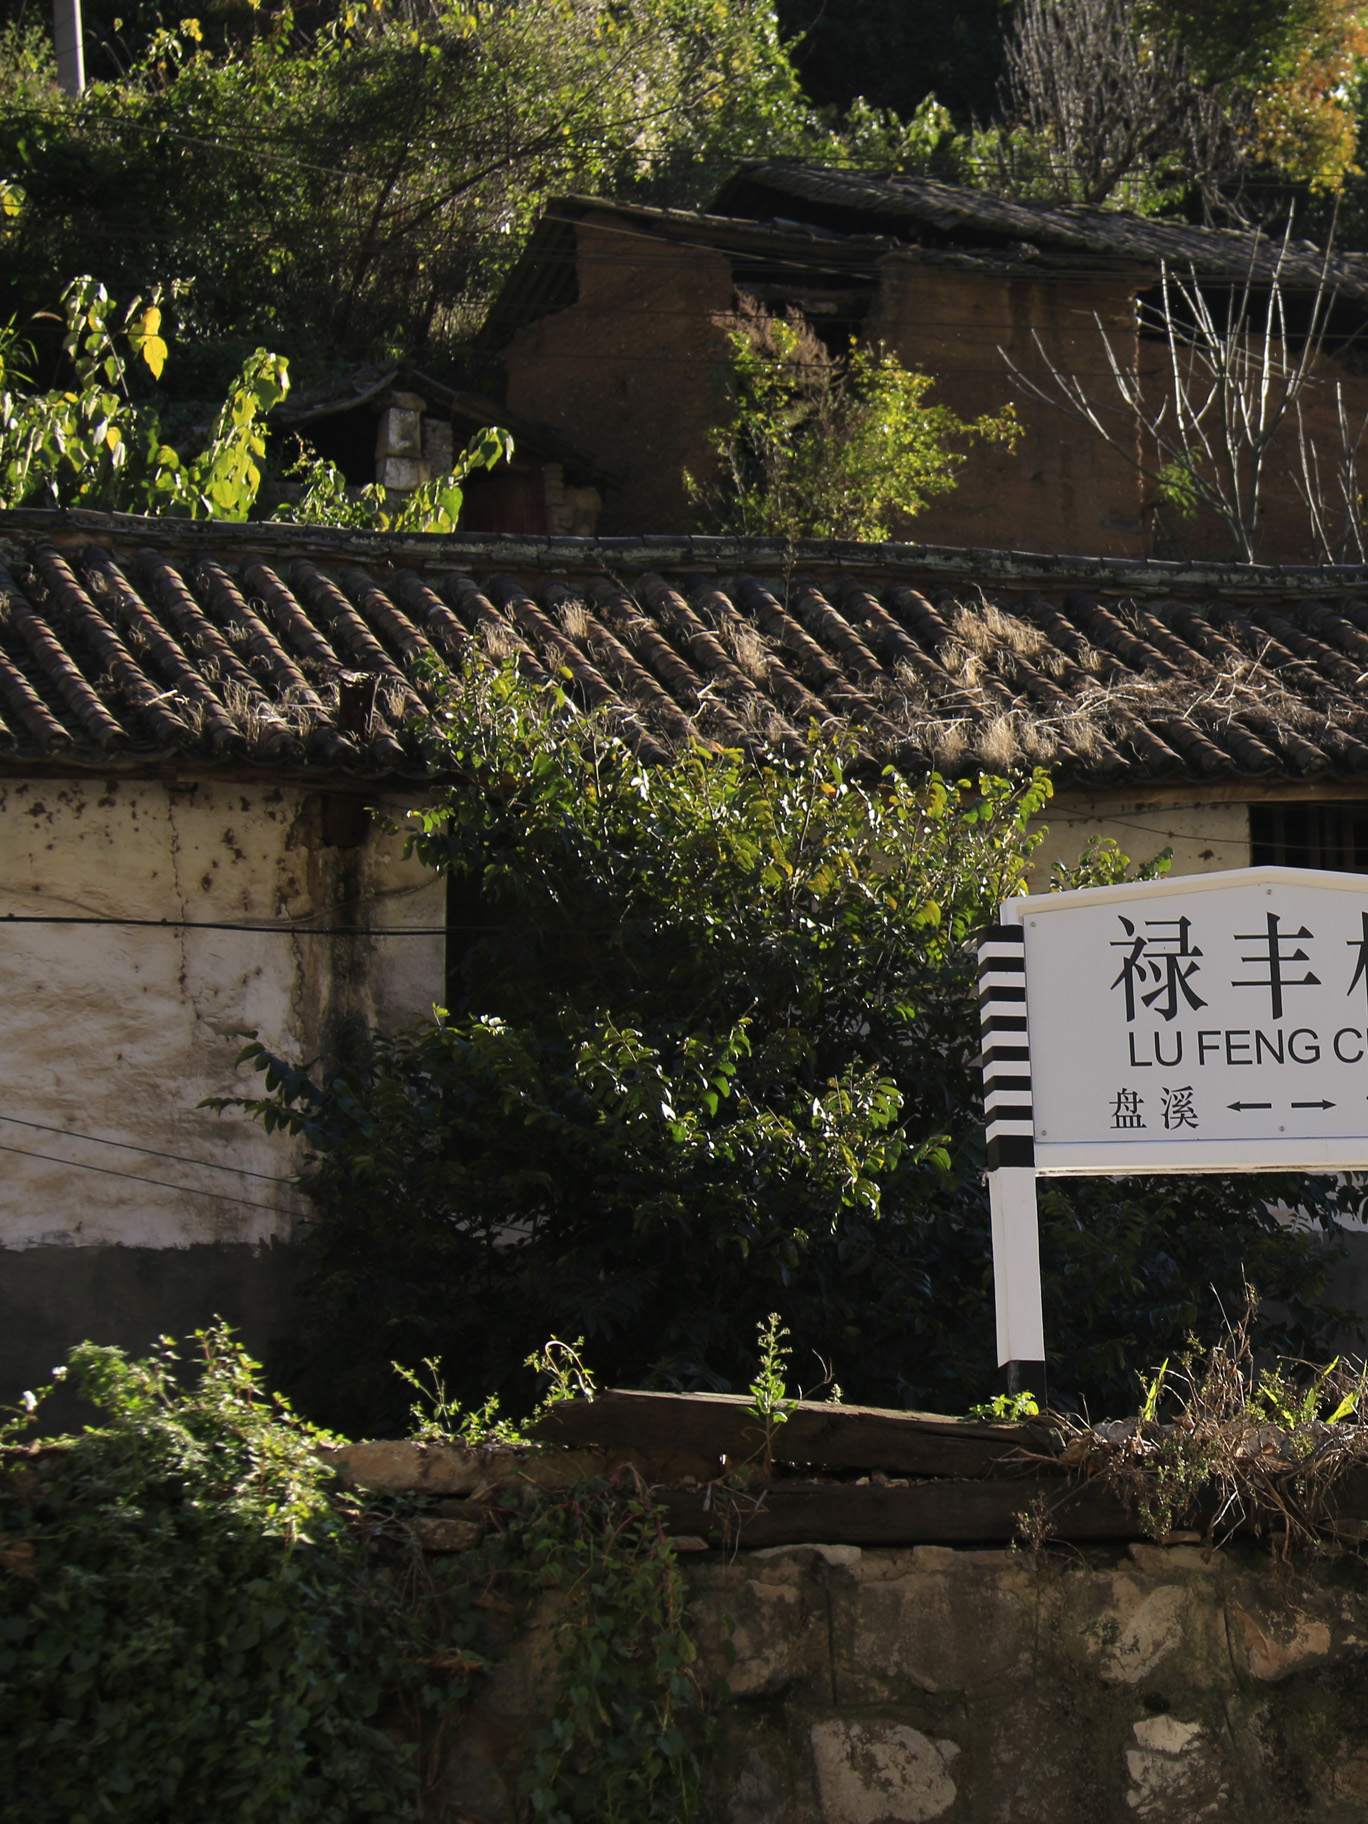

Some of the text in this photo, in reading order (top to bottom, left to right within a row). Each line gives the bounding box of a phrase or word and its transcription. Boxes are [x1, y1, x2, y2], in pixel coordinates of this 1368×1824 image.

[1128, 1031, 1183, 1067] LU
[1197, 1029, 1321, 1066] FENG
[1109, 1085, 1199, 1131] 盘溪
